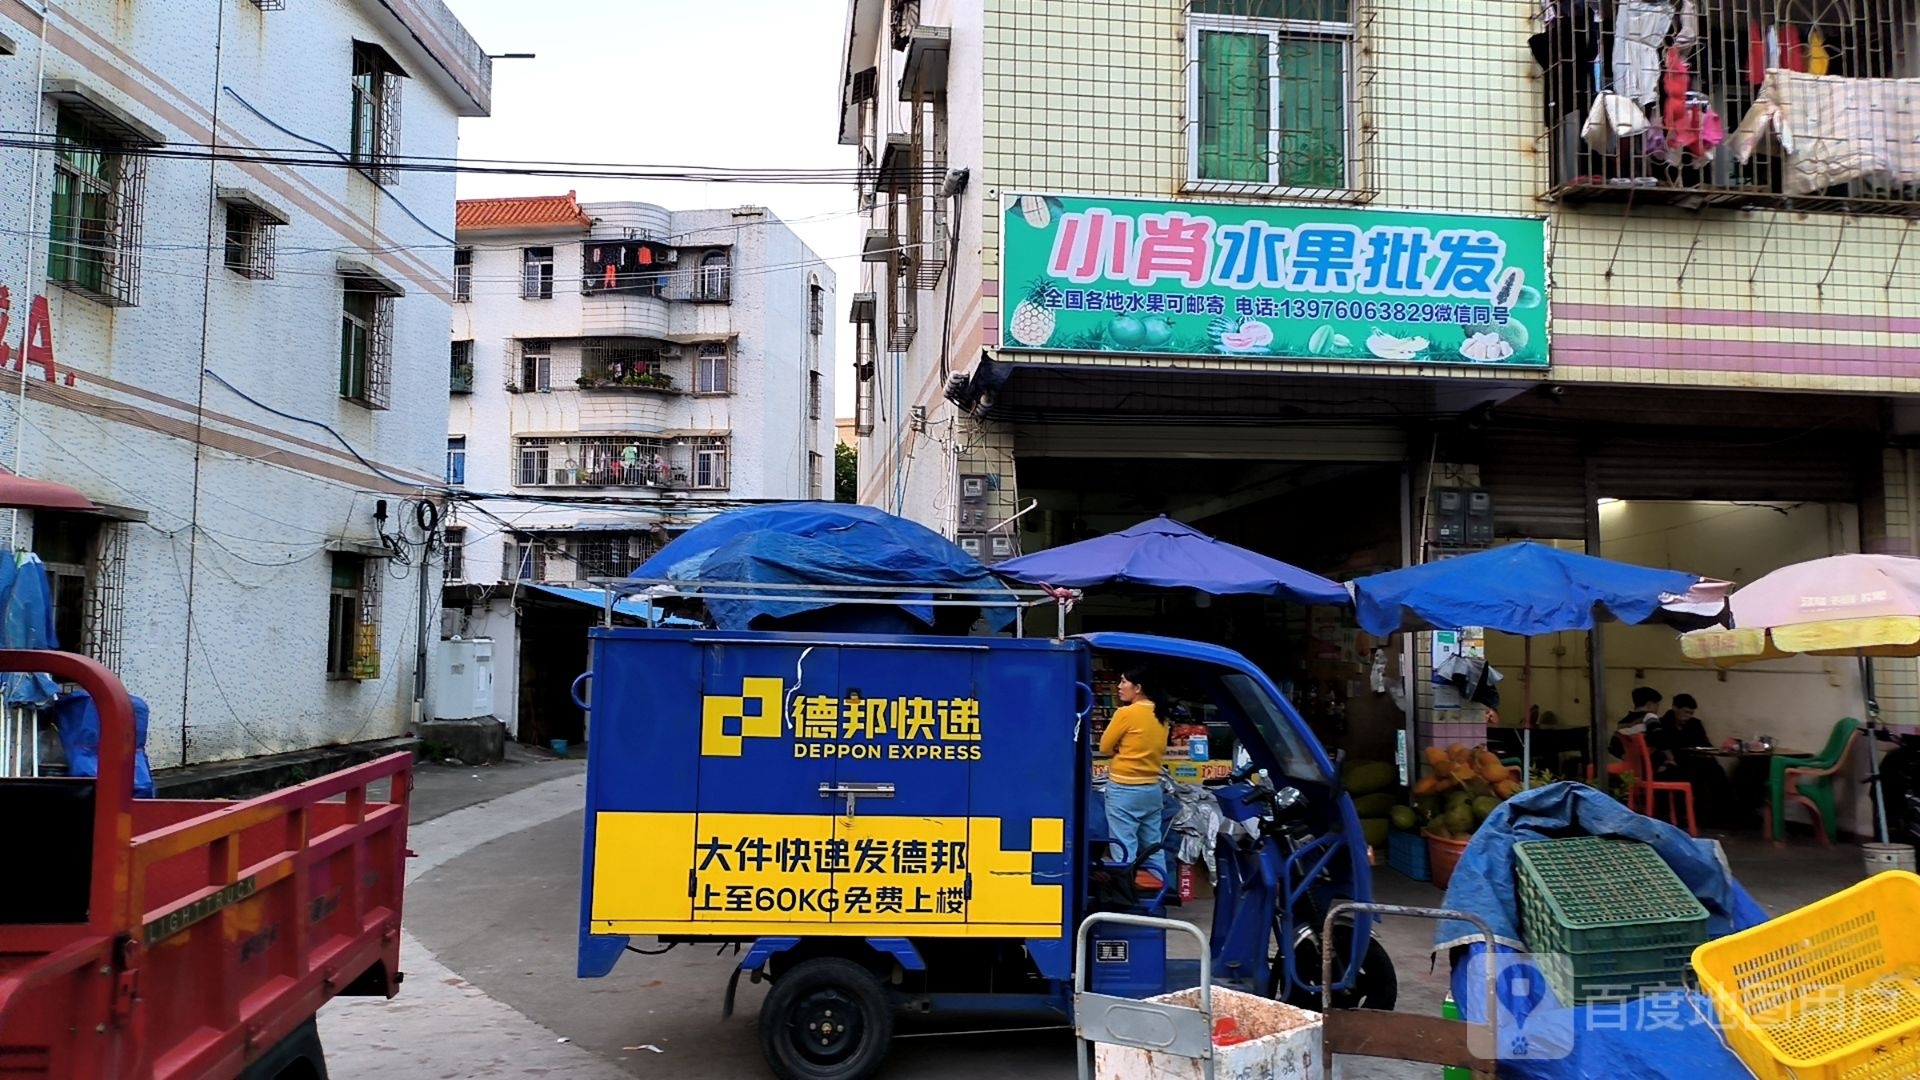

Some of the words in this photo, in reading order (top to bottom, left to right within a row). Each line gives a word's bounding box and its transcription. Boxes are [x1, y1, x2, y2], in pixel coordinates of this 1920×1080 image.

[1054, 213, 1499, 293] 小肖水果批发
[1045, 288, 1225, 316] 全国各地水果可邮寄
[791, 695, 982, 741] 德邦快递
[793, 743, 882, 759] DEPPON
[887, 744, 982, 760] EXPRESS
[697, 836, 966, 875] 大件快递发德邦
[694, 883, 964, 914] 上至60KG免费上楼
